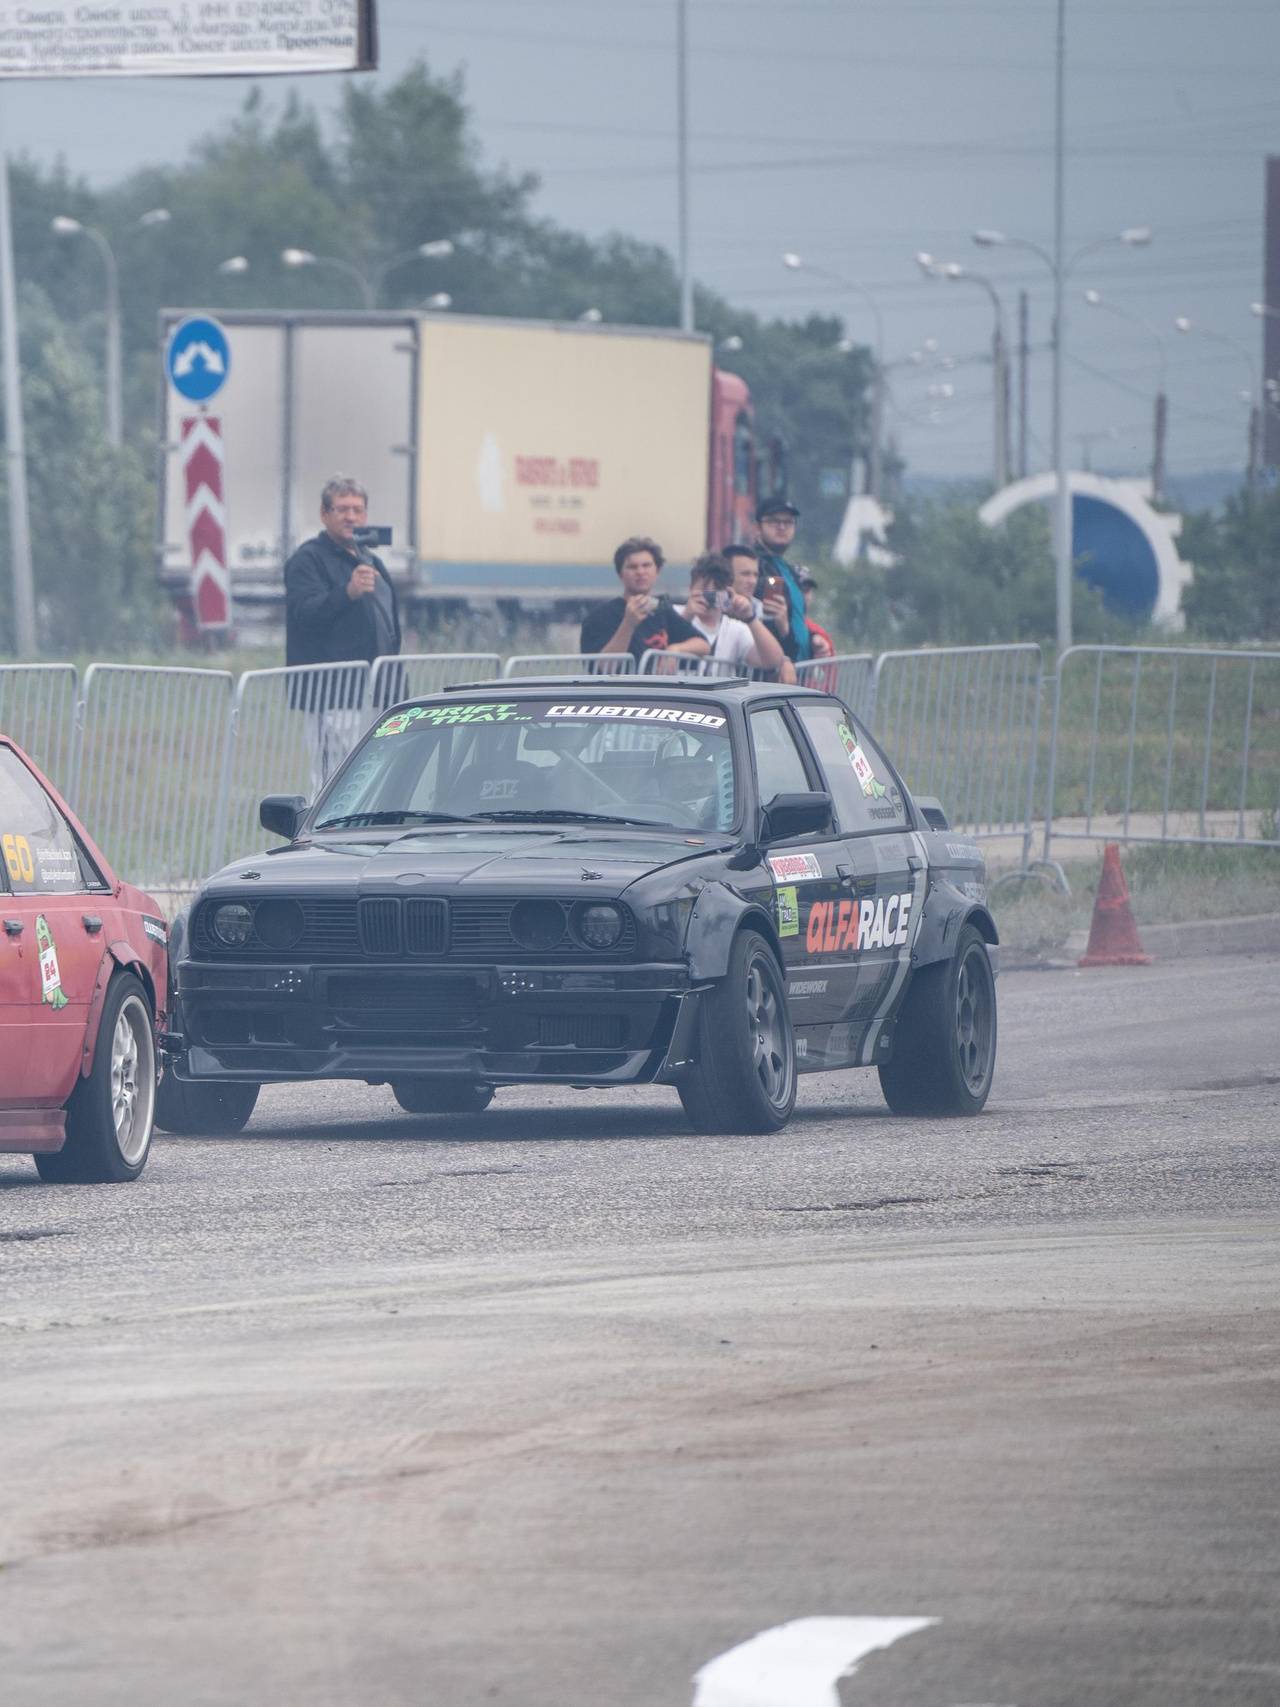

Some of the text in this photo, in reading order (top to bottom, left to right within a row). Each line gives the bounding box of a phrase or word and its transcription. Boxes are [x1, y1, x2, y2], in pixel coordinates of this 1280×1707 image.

[415, 703, 517, 719] DRIFT
[544, 705, 727, 728] CLUBTURBO
[3, 834, 35, 883] 60
[44, 960, 57, 981] 24
[789, 980, 828, 995] WIDEWORX
